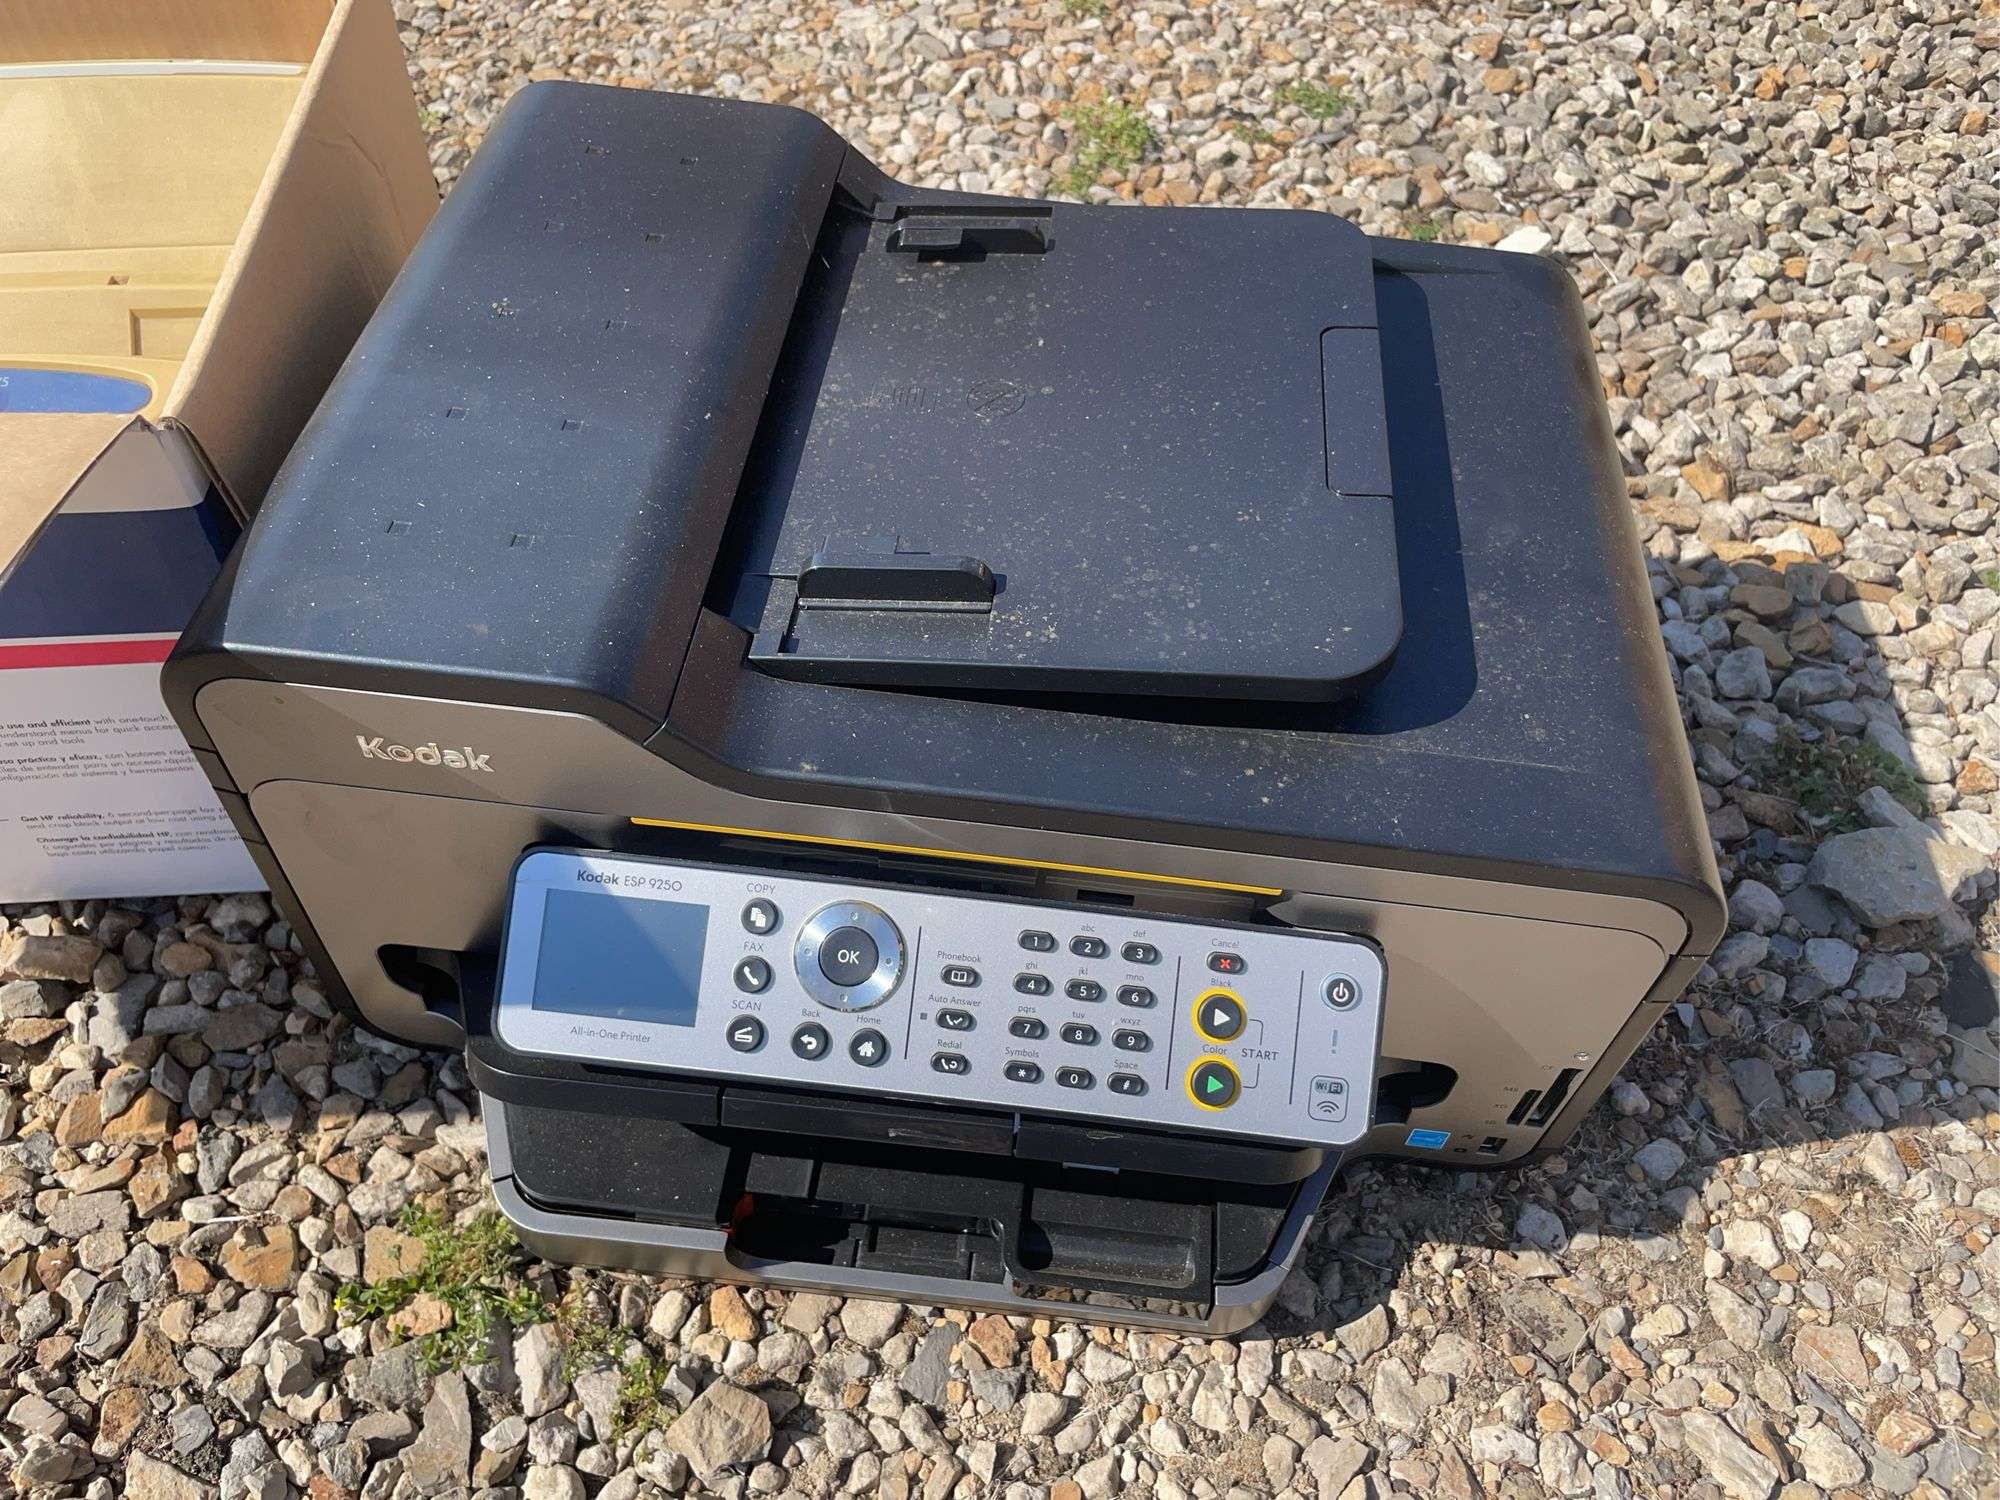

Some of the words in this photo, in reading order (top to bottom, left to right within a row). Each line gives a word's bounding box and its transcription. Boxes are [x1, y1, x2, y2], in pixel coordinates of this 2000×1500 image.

[27, 720, 47, 728] and
[50, 718, 91, 727] efficient
[356, 734, 495, 773] Kodak
[576, 869, 620, 885] Kodak
[623, 875, 646, 887] ESP
[648, 878, 683, 892] 9250
[746, 882, 776, 895] COPY
[1080, 924, 1096, 933] abc
[1132, 929, 1147, 938] def
[743, 941, 765, 953] FAX
[1032, 936, 1038, 947] 1
[1084, 942, 1092, 953] 2
[1211, 938, 1240, 949] Cancel
[837, 949, 861, 965] OK
[936, 950, 982, 964] Phonebook
[1136, 948, 1144, 960] 3
[1025, 961, 1039, 970] ghi
[1078, 967, 1089, 976] jkl
[1125, 973, 1145, 981] mno
[1210, 977, 1233, 989] Black
[1027, 980, 1035, 991] 4
[1079, 986, 1087, 997] 5
[927, 994, 949, 1004] Auto
[950, 996, 982, 1007] Answer
[1131, 992, 1139, 1003] 6
[731, 999, 762, 1011] SCAN
[1017, 1005, 1036, 1014] pqrs
[801, 1007, 821, 1018] Back
[1072, 1010, 1086, 1019] tuv
[856, 1014, 881, 1025] Home
[1119, 1016, 1142, 1026] wxyz
[569, 1025, 619, 1040] All-in-One
[620, 1030, 651, 1043] Printer
[1023, 1023, 1031, 1034] 7
[1075, 1029, 1083, 1041] 8
[1127, 1035, 1136, 1047] 9
[936, 1038, 963, 1050] Redial
[1202, 1043, 1229, 1055] Color
[1004, 1046, 1040, 1059] Symbols
[1241, 1047, 1279, 1061] START
[1113, 1059, 1139, 1071] Space
[1069, 1073, 1079, 1085] 0
